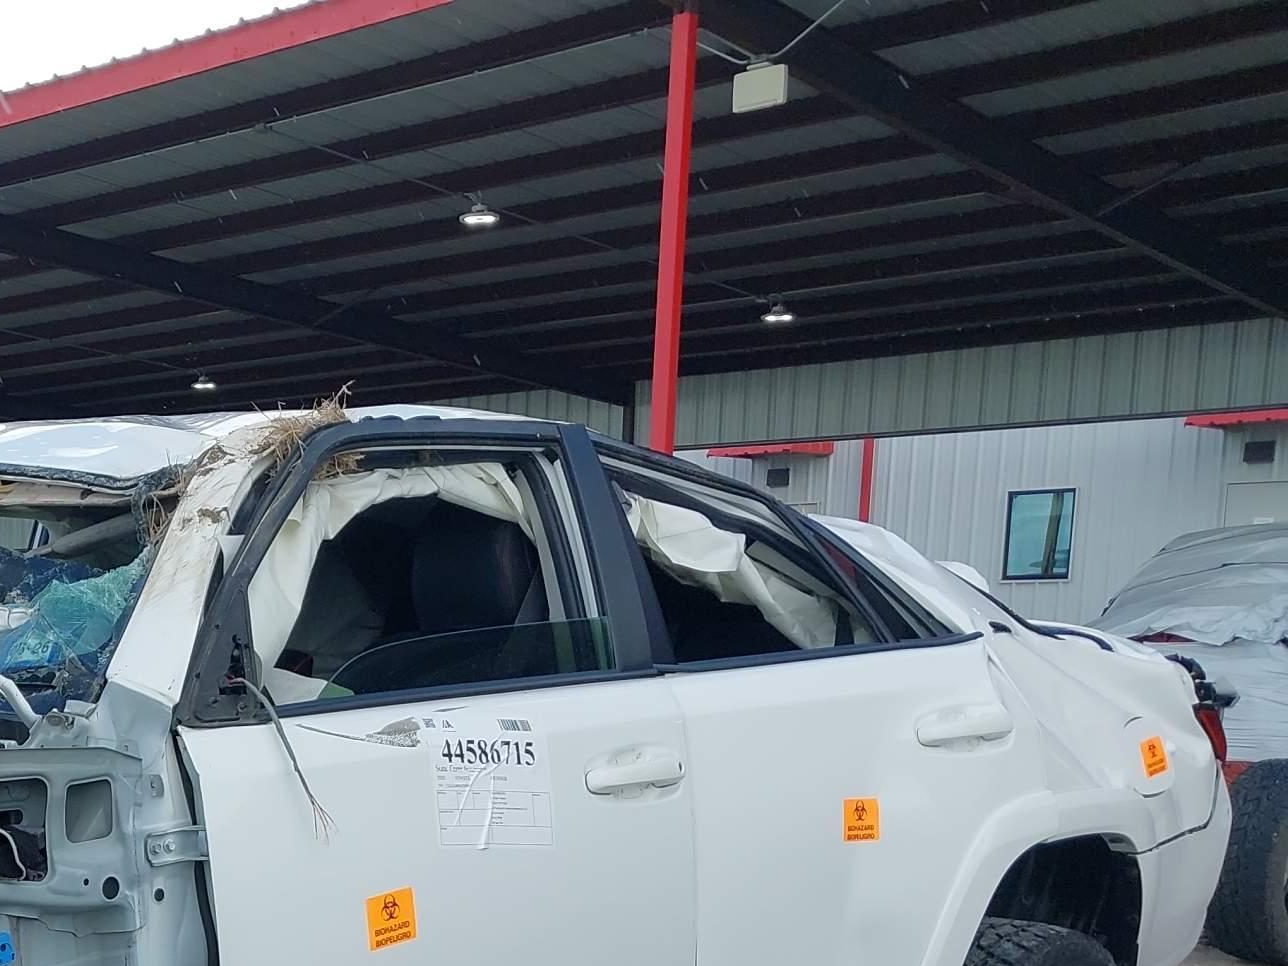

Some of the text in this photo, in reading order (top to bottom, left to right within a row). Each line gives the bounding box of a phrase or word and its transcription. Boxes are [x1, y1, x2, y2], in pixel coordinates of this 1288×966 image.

[441, 738, 536, 766] 44586715
[374, 920, 410, 937] BIOHAZARD
[375, 930, 411, 947] BIOPELIGRO
